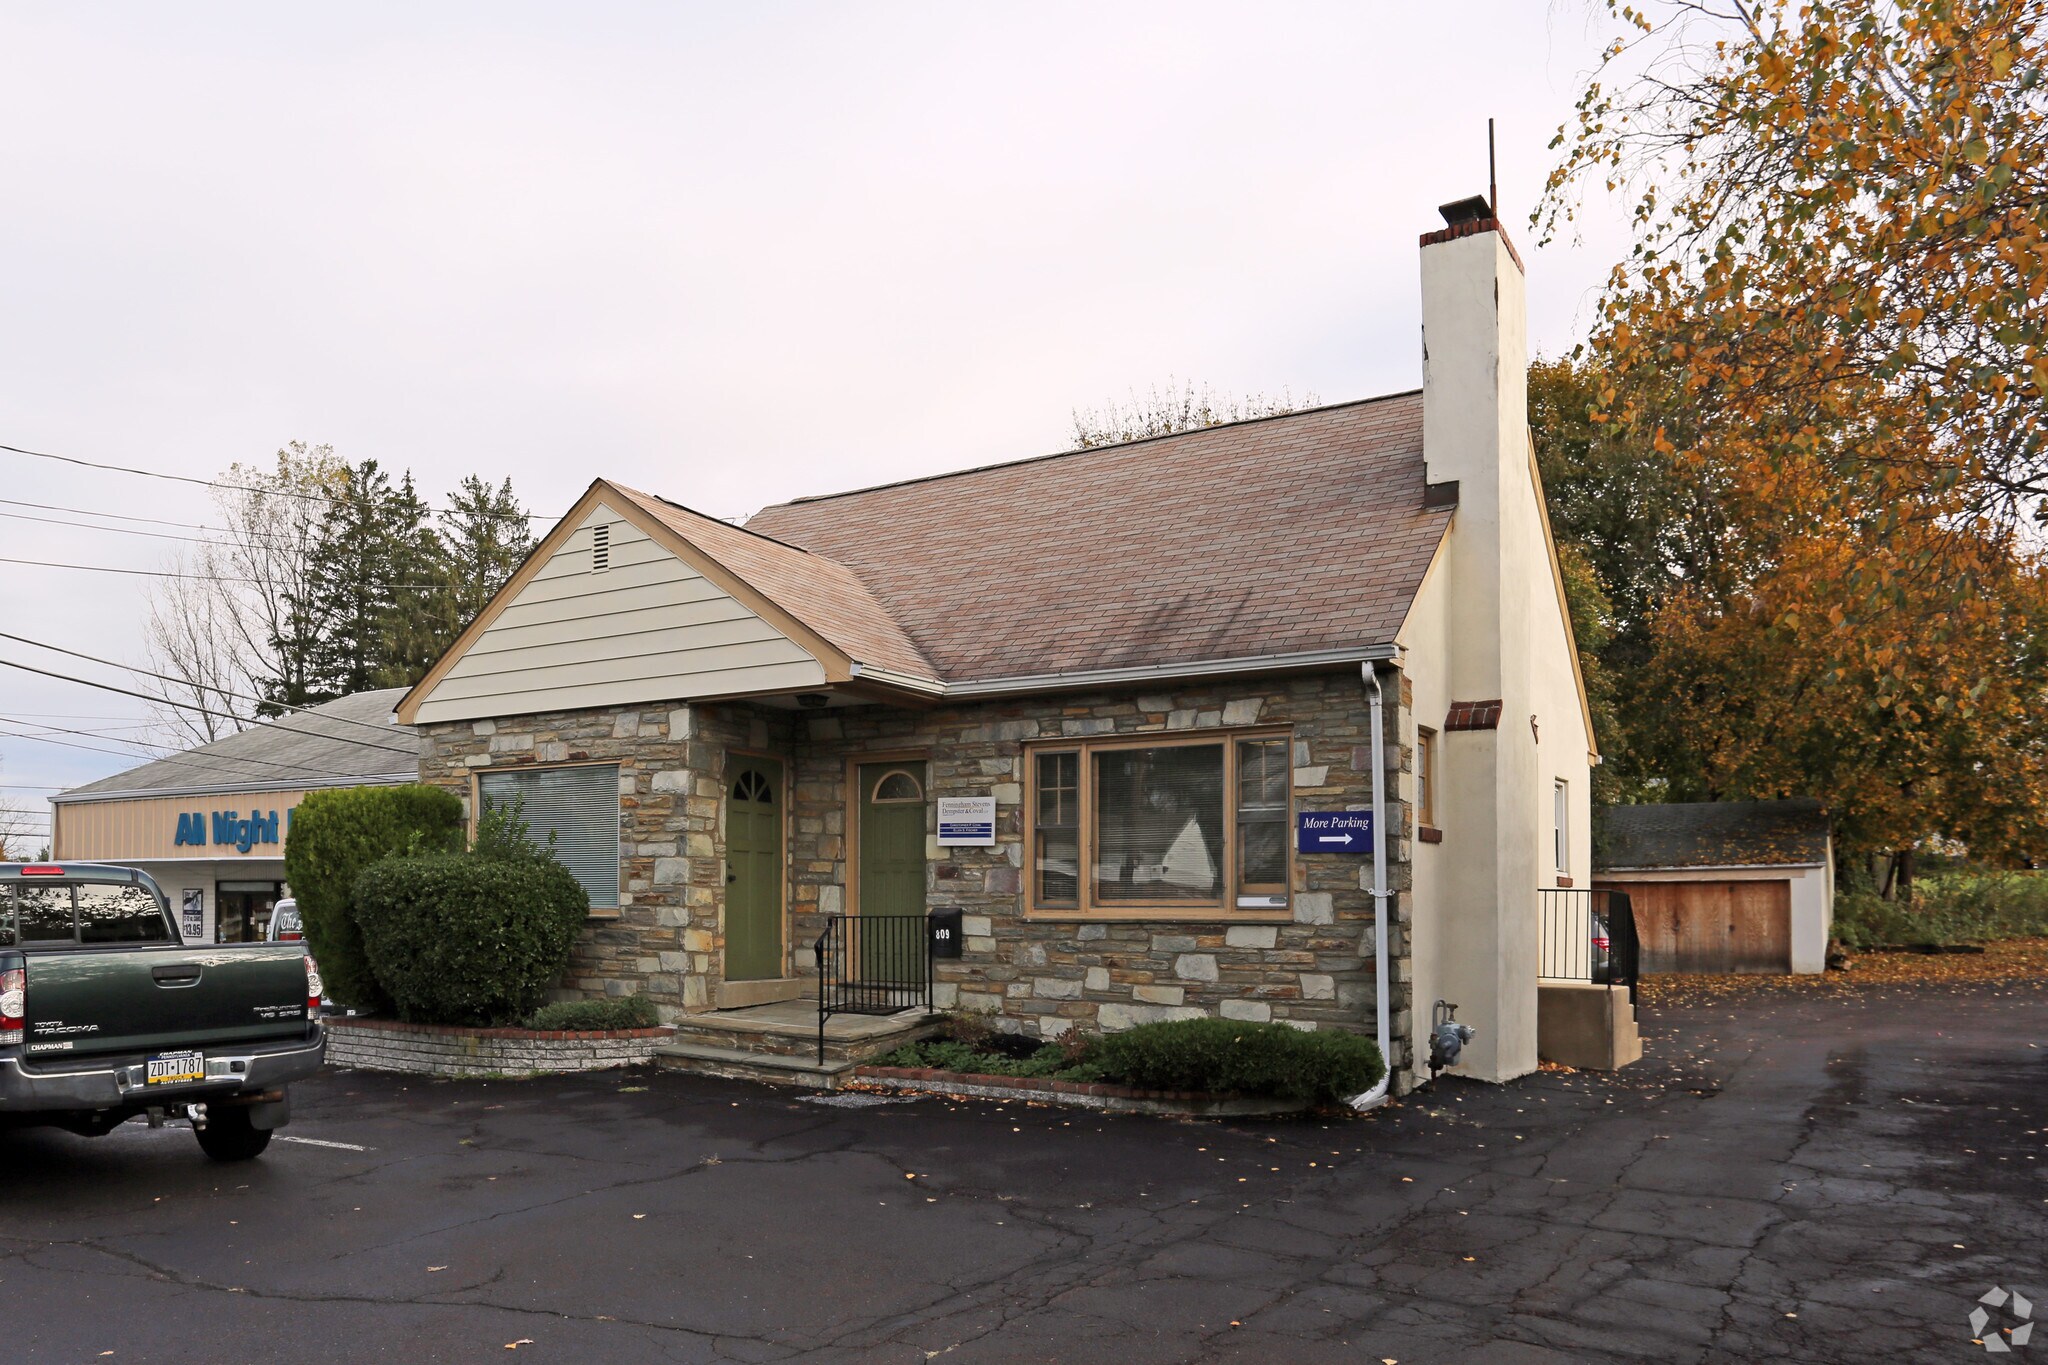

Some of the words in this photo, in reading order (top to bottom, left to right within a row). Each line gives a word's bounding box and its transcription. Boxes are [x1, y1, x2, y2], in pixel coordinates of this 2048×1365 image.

[1304, 818, 1328, 828] More
[1331, 816, 1368, 830] Parking
[174, 812, 206, 846] All
[212, 810, 279, 854] Night
[281, 912, 296, 929] The
[936, 929, 950, 939] 809
[34, 1024, 100, 1034] TACOMA
